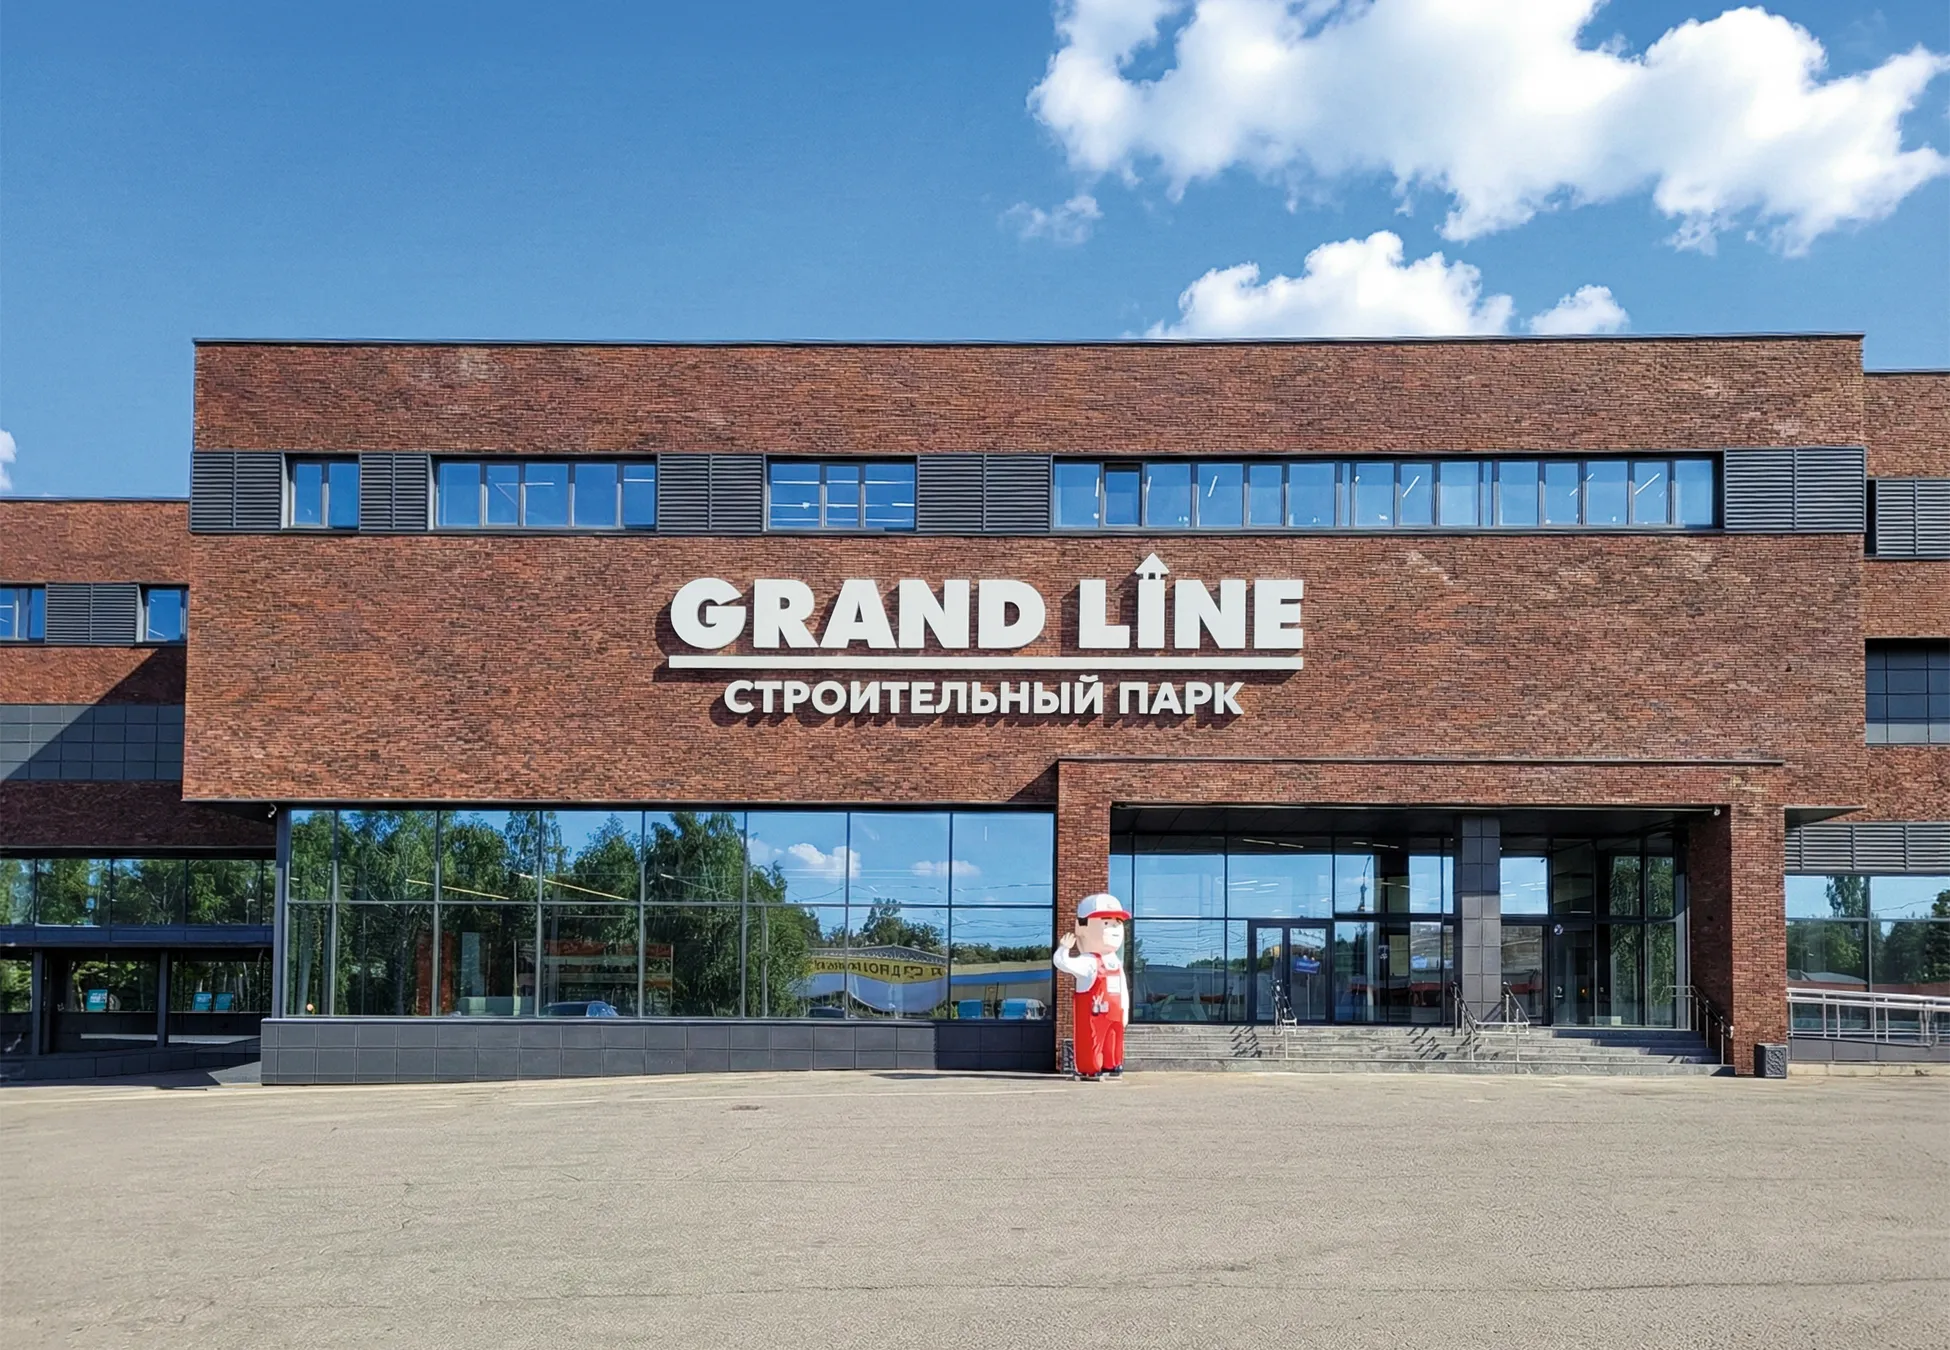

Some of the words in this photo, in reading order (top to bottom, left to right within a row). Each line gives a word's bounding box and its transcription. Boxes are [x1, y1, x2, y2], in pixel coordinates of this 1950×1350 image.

[670, 577, 1047, 650] GRAND
[1078, 552, 1305, 650] LINE
[724, 674, 1104, 715] СТРОИТЕЛЬНЫЙ
[1119, 681, 1245, 715] ПАРК
